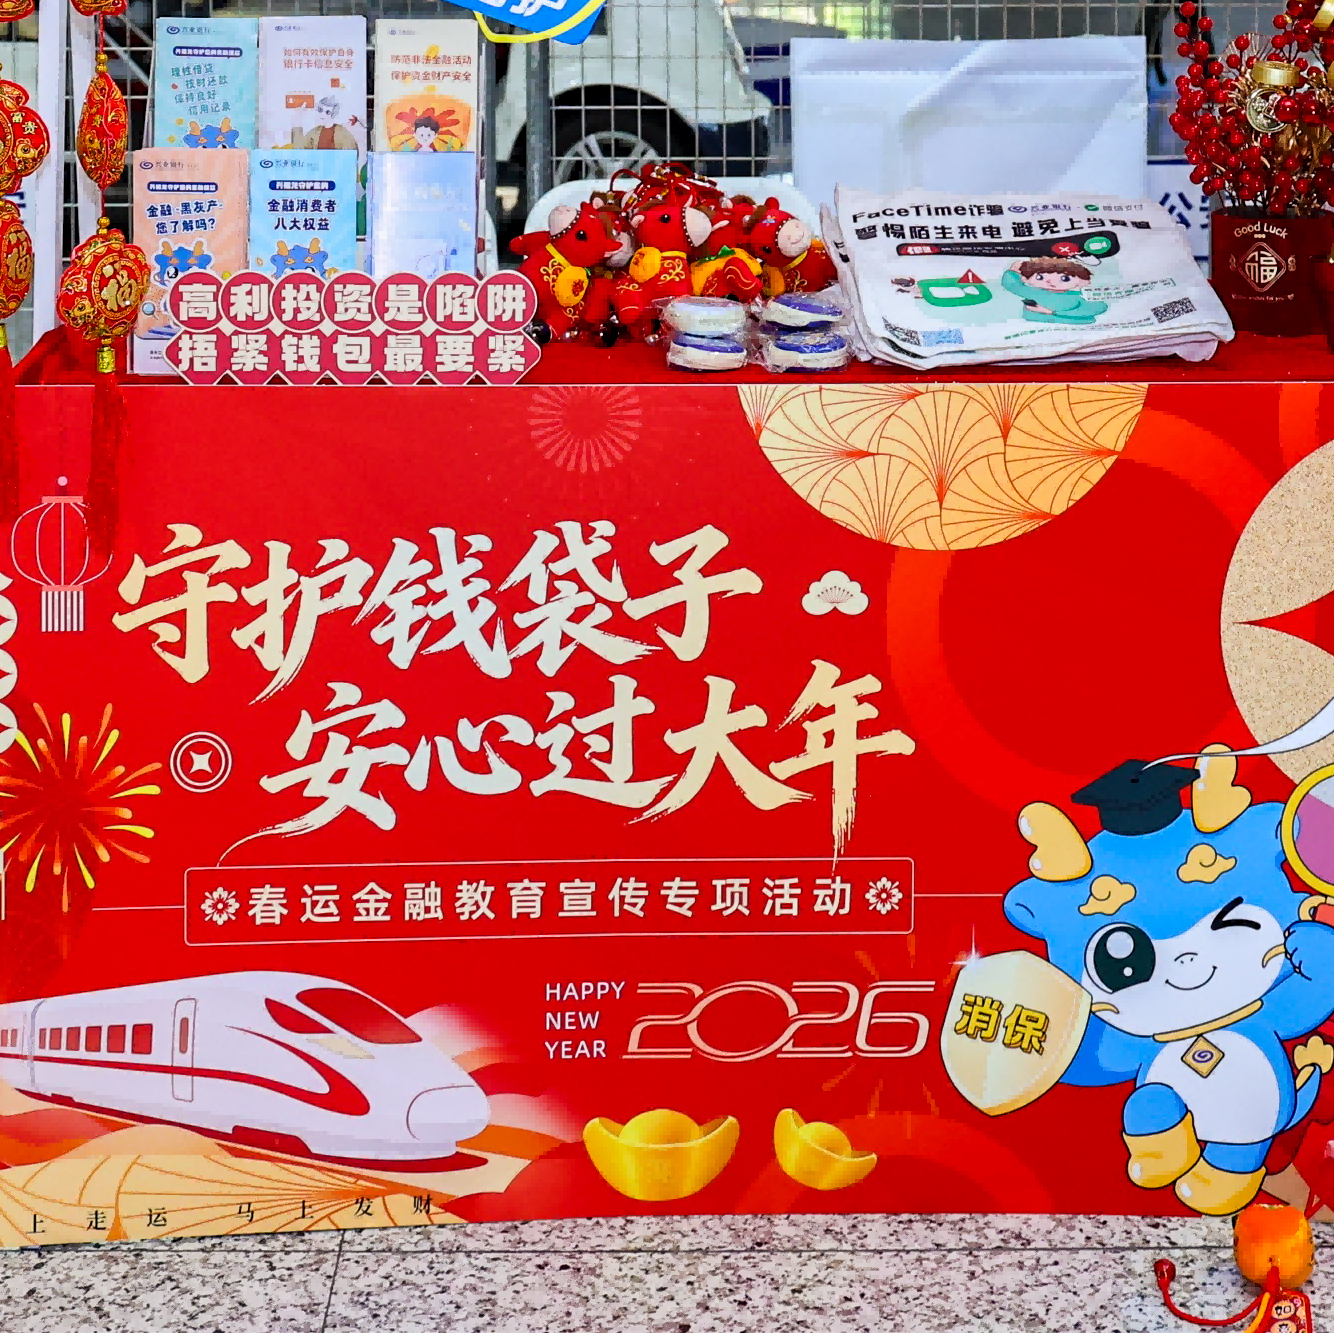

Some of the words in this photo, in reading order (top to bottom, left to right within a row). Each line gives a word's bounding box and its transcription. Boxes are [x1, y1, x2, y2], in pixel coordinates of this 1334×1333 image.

[283, 58, 354, 69] 银行卡信息安全
[390, 54, 472, 65] 防范非法金融活动
[171, 63, 214, 77] 理性借贷
[390, 70, 472, 81] 保护资金财产安全
[185, 75, 229, 89] 按时还款
[174, 90, 217, 105] 保持良好
[188, 102, 231, 116] 信用记录
[267, 199, 337, 213] 金融消费者
[274, 217, 331, 231] 八大权益
[855, 222, 1003, 240] 警惕陌生来电
[1234, 221, 1261, 237] Good
[1263, 222, 1288, 239] Luck
[7, 230, 33, 281] 福
[101, 258, 139, 313] 福
[178, 282, 529, 323] 高利投资是陷阱
[177, 333, 527, 373] 捂紧钱包最要紧
[113, 519, 762, 704] 守护钱袋子
[218, 660, 914, 870] 安心过大年
[246, 875, 855, 925] 春运金融教育宣传专项活动
[544, 982, 624, 1003] HAPPY
[544, 1011, 599, 1032] NEW
[622, 980, 936, 1063] 2026
[954, 992, 1051, 1054] 消保
[544, 1040, 606, 1060] YEAR
[236, 1192, 436, 1224] 马上发财
